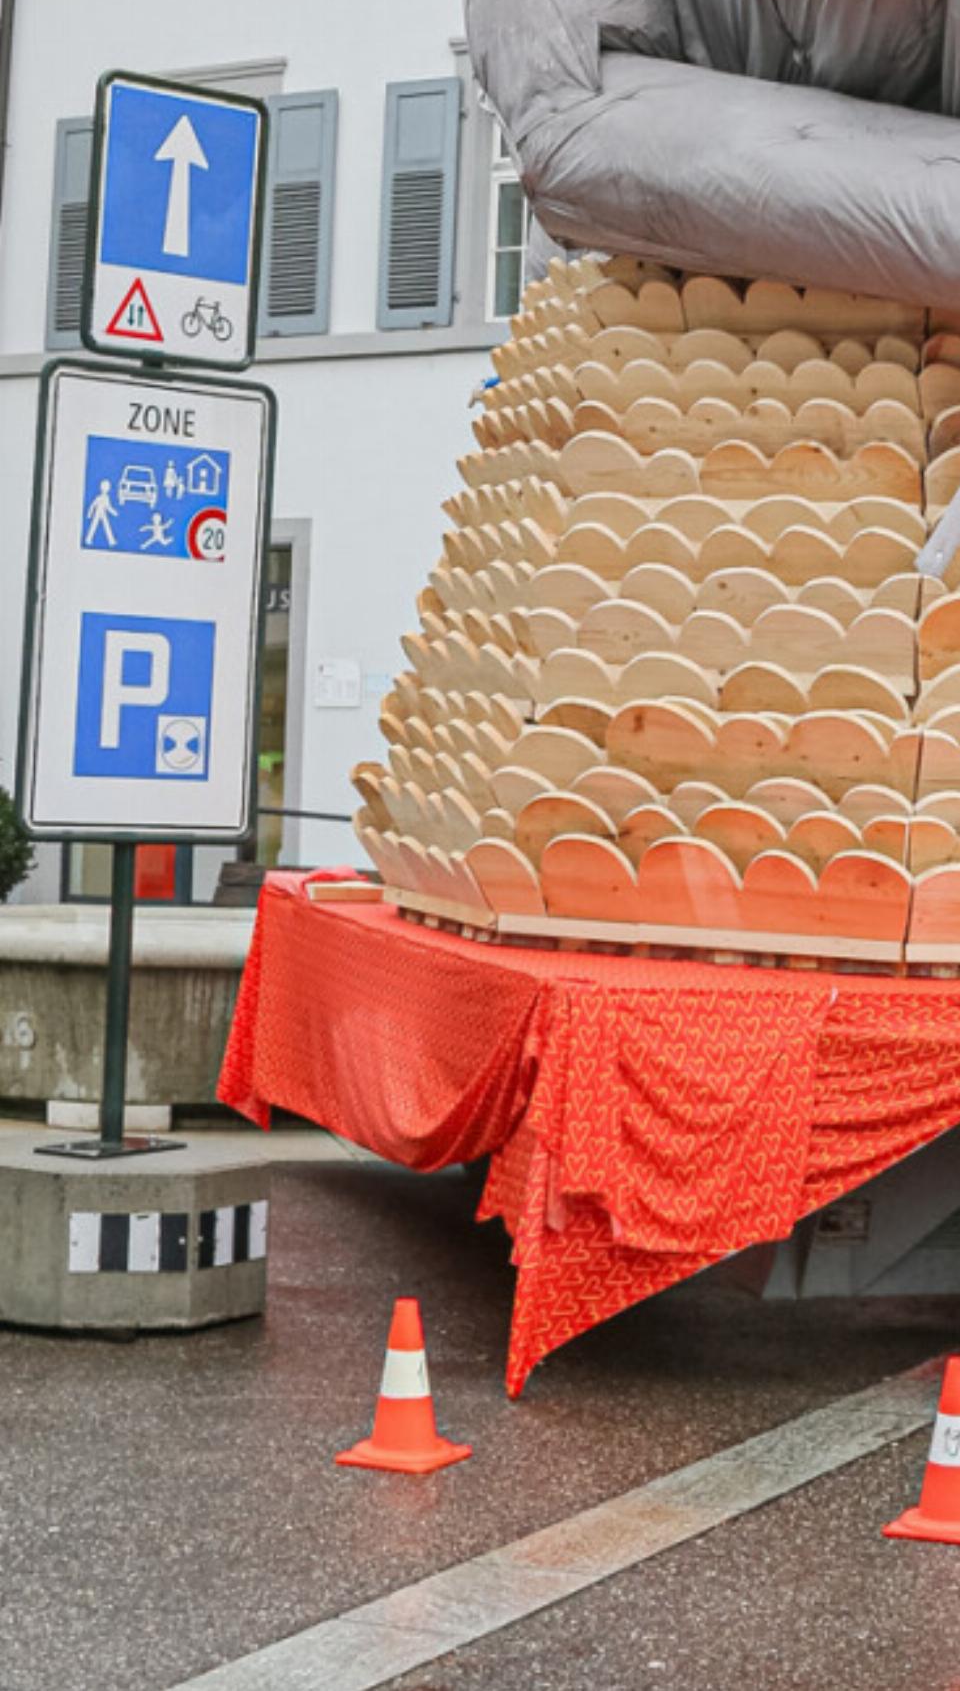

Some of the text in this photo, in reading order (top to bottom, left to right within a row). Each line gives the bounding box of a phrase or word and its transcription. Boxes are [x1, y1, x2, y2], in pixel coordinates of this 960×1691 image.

[127, 402, 196, 438] ZONE
[202, 527, 225, 550] 20
[100, 629, 171, 749] P
